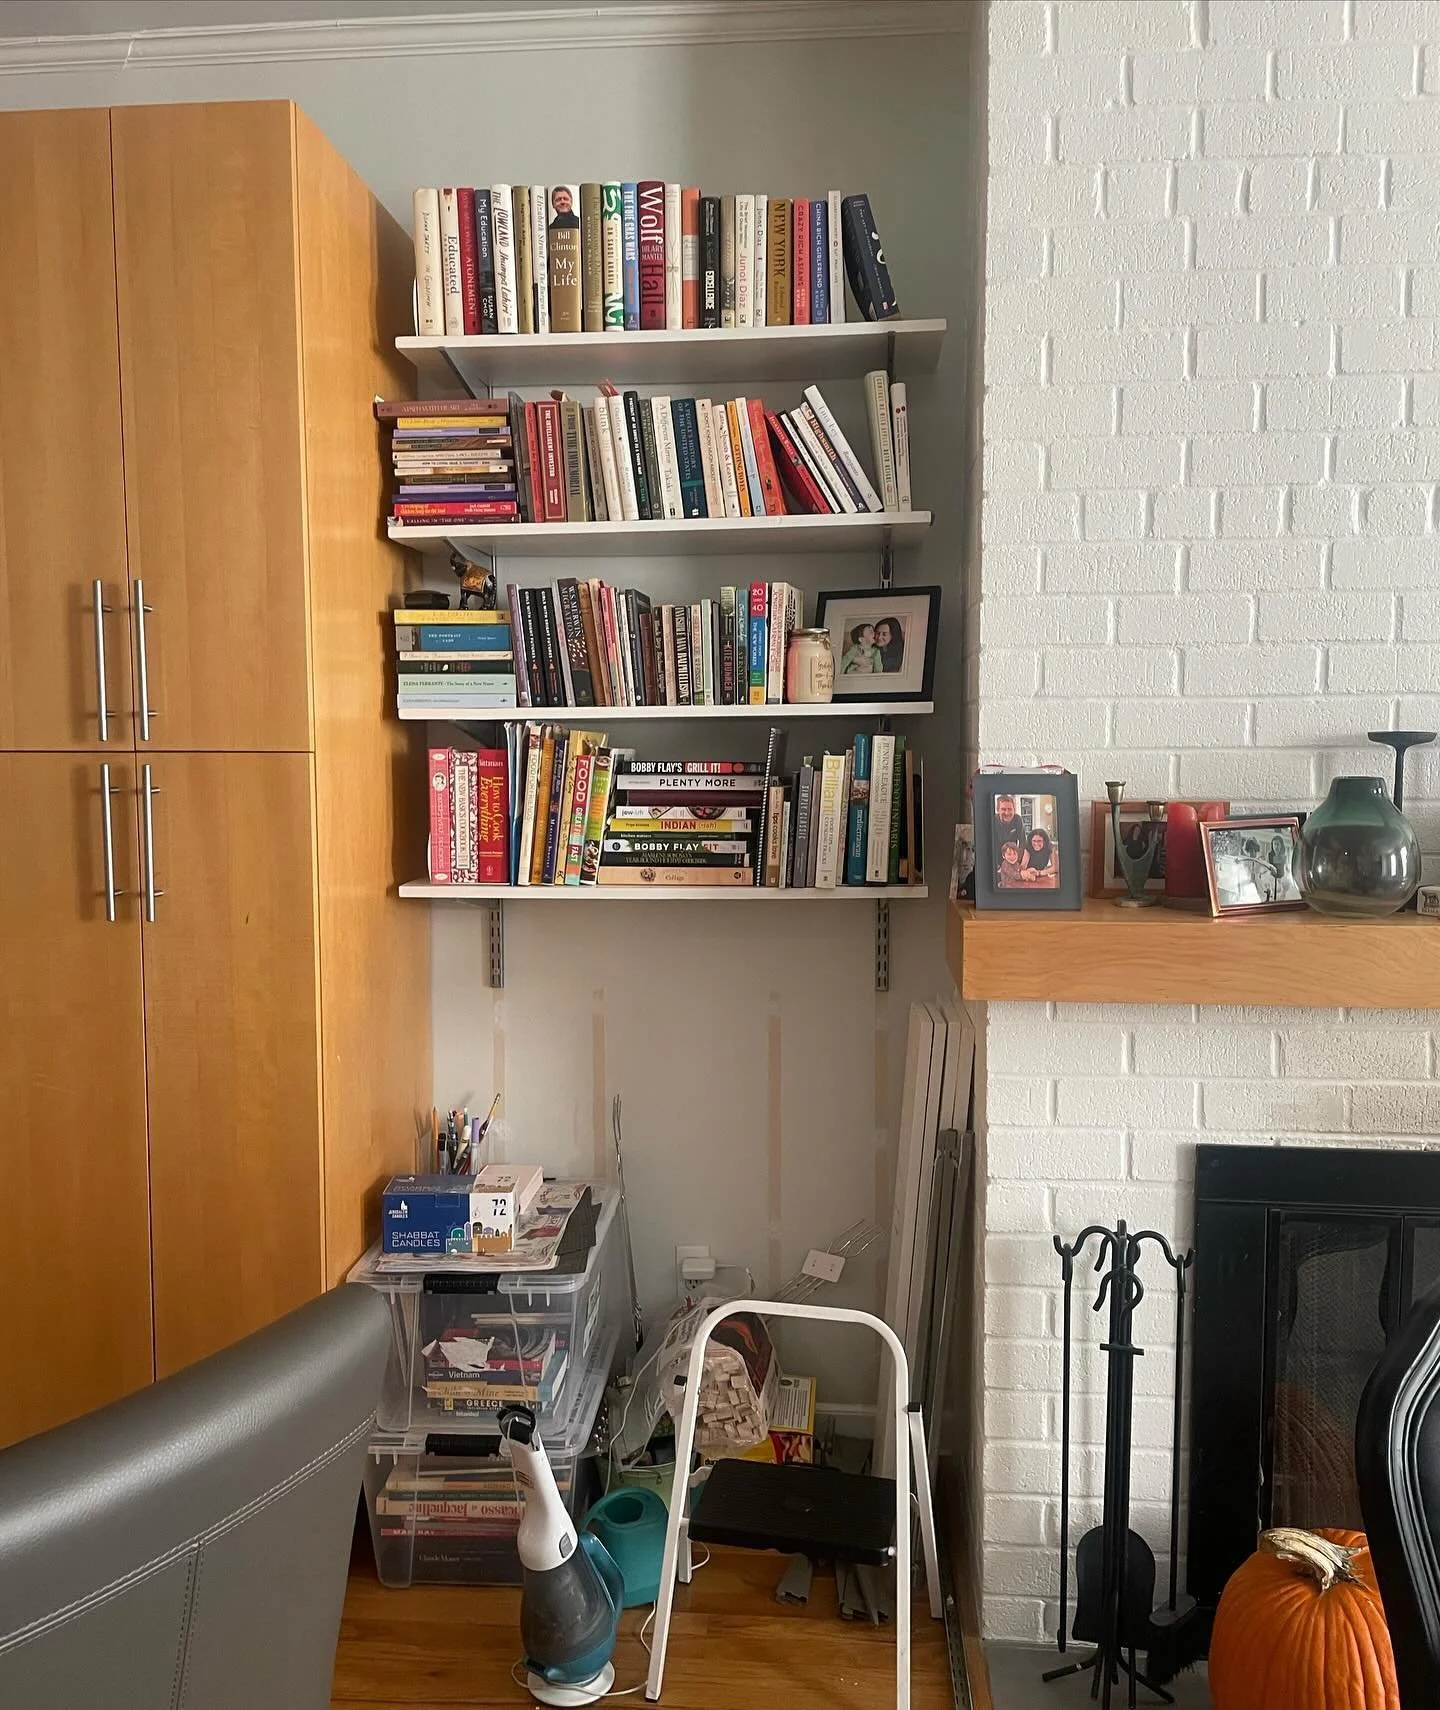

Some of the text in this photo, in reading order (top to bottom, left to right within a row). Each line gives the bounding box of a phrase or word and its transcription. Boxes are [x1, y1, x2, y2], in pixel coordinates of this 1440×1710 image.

[478, 199, 488, 258] My Education
[492, 192, 510, 247] THE LOWLAND
[624, 191, 635, 261] THE FOIE GRAS WARS
[640, 186, 664, 243] Wolf
[538, 234, 546, 258] Strout
[550, 242, 577, 251] Clinton
[558, 231, 570, 240] Bill
[773, 203, 785, 278] NEW YORK
[447, 235, 460, 294] Educated
[555, 258, 576, 272] My
[739, 253, 747, 282] Junot
[465, 257, 476, 315] ATONEMENT
[498, 250, 512, 314] Jhumpa Lahiri
[553, 274, 578, 287] Life
[641, 263, 663, 305] Hall
[705, 270, 714, 309] EXCELLENCE
[598, 407, 609, 433] blink
[678, 403, 683, 411] OF
[566, 431, 576, 449] TIME
[680, 429, 688, 454] UNITED
[689, 440, 697, 469] HISTORY
[810, 420, 838, 461] Highsmith
[547, 453, 555, 477] INVESTOR
[720, 430, 731, 453] Shoots
[726, 463, 734, 486] Leaves
[567, 451, 580, 497] IMMEMORIAL
[752, 588, 764, 596] 20
[561, 587, 574, 638] MIGRATION
[571, 600, 581, 637] MERWIN
[752, 604, 764, 612] 40
[675, 607, 689, 698] INVISIBLE MAN RALPH ELLISON
[724, 645, 733, 690] KITE RUNNER
[631, 762, 720, 774] BOBBY FLAY'S GRILL IT!
[881, 742, 890, 770] JUNIOR
[576, 759, 589, 802] FOOD
[659, 779, 736, 787] PLENTY MORE
[823, 759, 841, 815] Brilliant
[458, 769, 467, 853] THE NEW BASICS COOKBOOK
[478, 775, 493, 843] Everything
[493, 776, 504, 842] How to Cook
[798, 785, 810, 839] SIMPLY CLASSIC
[891, 754, 902, 848] BAREFOOT IN PARIS
[574, 807, 584, 826] GREAT
[661, 820, 696, 829] INDIAN
[772, 812, 780, 824] tips
[634, 843, 719, 851] BOBBY FLAY FIT
[855, 809, 864, 857] mediterranean
[570, 846, 579, 862] FAST
[492, 1199, 507, 1216] 72
[391, 1231, 440, 1240] SHABBAT
[391, 1239, 441, 1248] CANDLES
[448, 1370, 480, 1379] Vietnam
[466, 1399, 503, 1408] GREECE
[408, 1501, 468, 1517] Jacqueline
